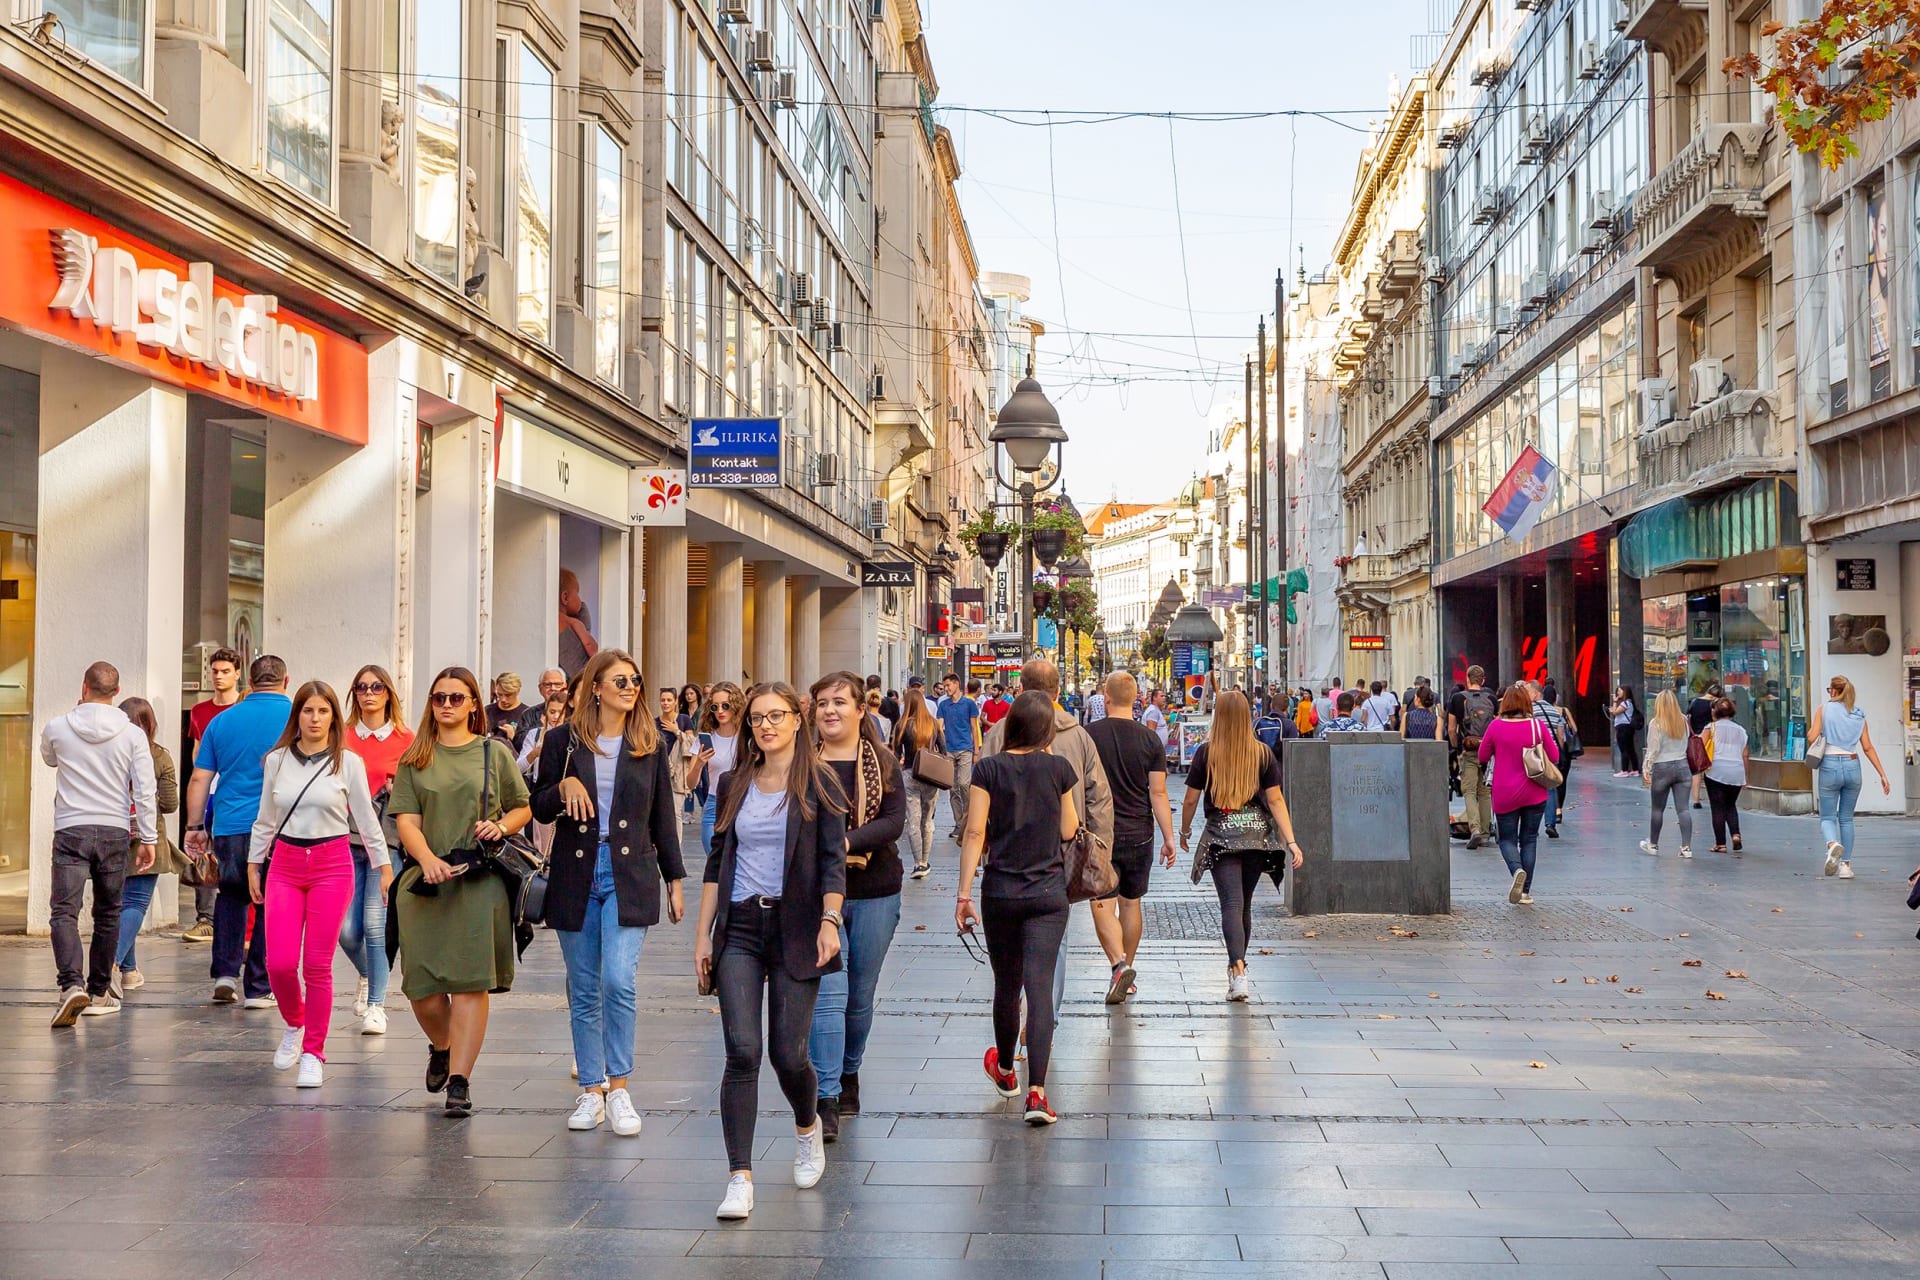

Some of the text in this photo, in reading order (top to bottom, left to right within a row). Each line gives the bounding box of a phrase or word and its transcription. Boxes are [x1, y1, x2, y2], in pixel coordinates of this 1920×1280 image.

[721, 432, 778, 443] ILIRIKA
[711, 457, 759, 468] Kontakt
[556, 450, 570, 493] vip
[692, 473, 777, 483] 011-330-1000
[630, 512, 645, 523] vip
[864, 573, 913, 582] ZARA
[998, 573, 1006, 613] HOTEL
[959, 631, 983, 639] AIRSTEP
[1359, 804, 1379, 814] 1987
[1227, 812, 1261, 822] sweet
[1221, 820, 1267, 830] revenge
